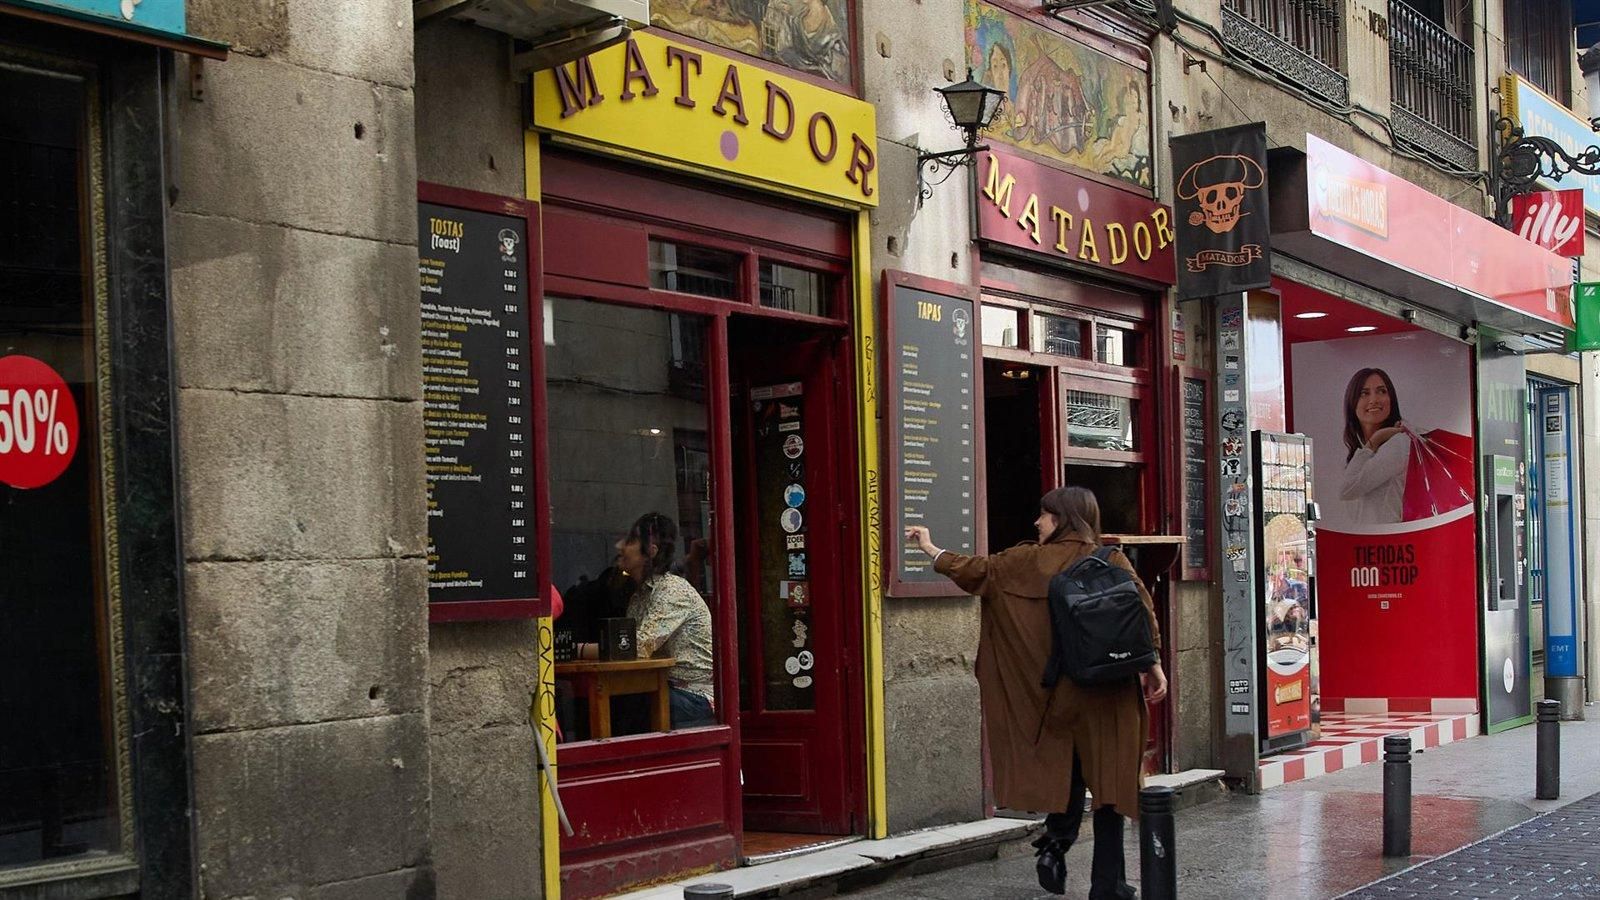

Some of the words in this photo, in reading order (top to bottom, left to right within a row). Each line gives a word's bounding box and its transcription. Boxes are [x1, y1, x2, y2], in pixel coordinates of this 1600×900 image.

[554, 39, 875, 196] MATADOR
[983, 153, 1174, 265] MATADOR
[430, 218, 464, 237] TOSTAS
[1518, 201, 1580, 252] illy
[431, 234, 460, 253] (Toast)
[1200, 252, 1246, 264] MATADOR
[917, 302, 942, 322] TAPAS
[1486, 382, 1519, 423] ATM
[1353, 544, 1415, 566] TIENDAS
[1381, 566, 1418, 586] STOP
[1551, 644, 1568, 652] EMT
